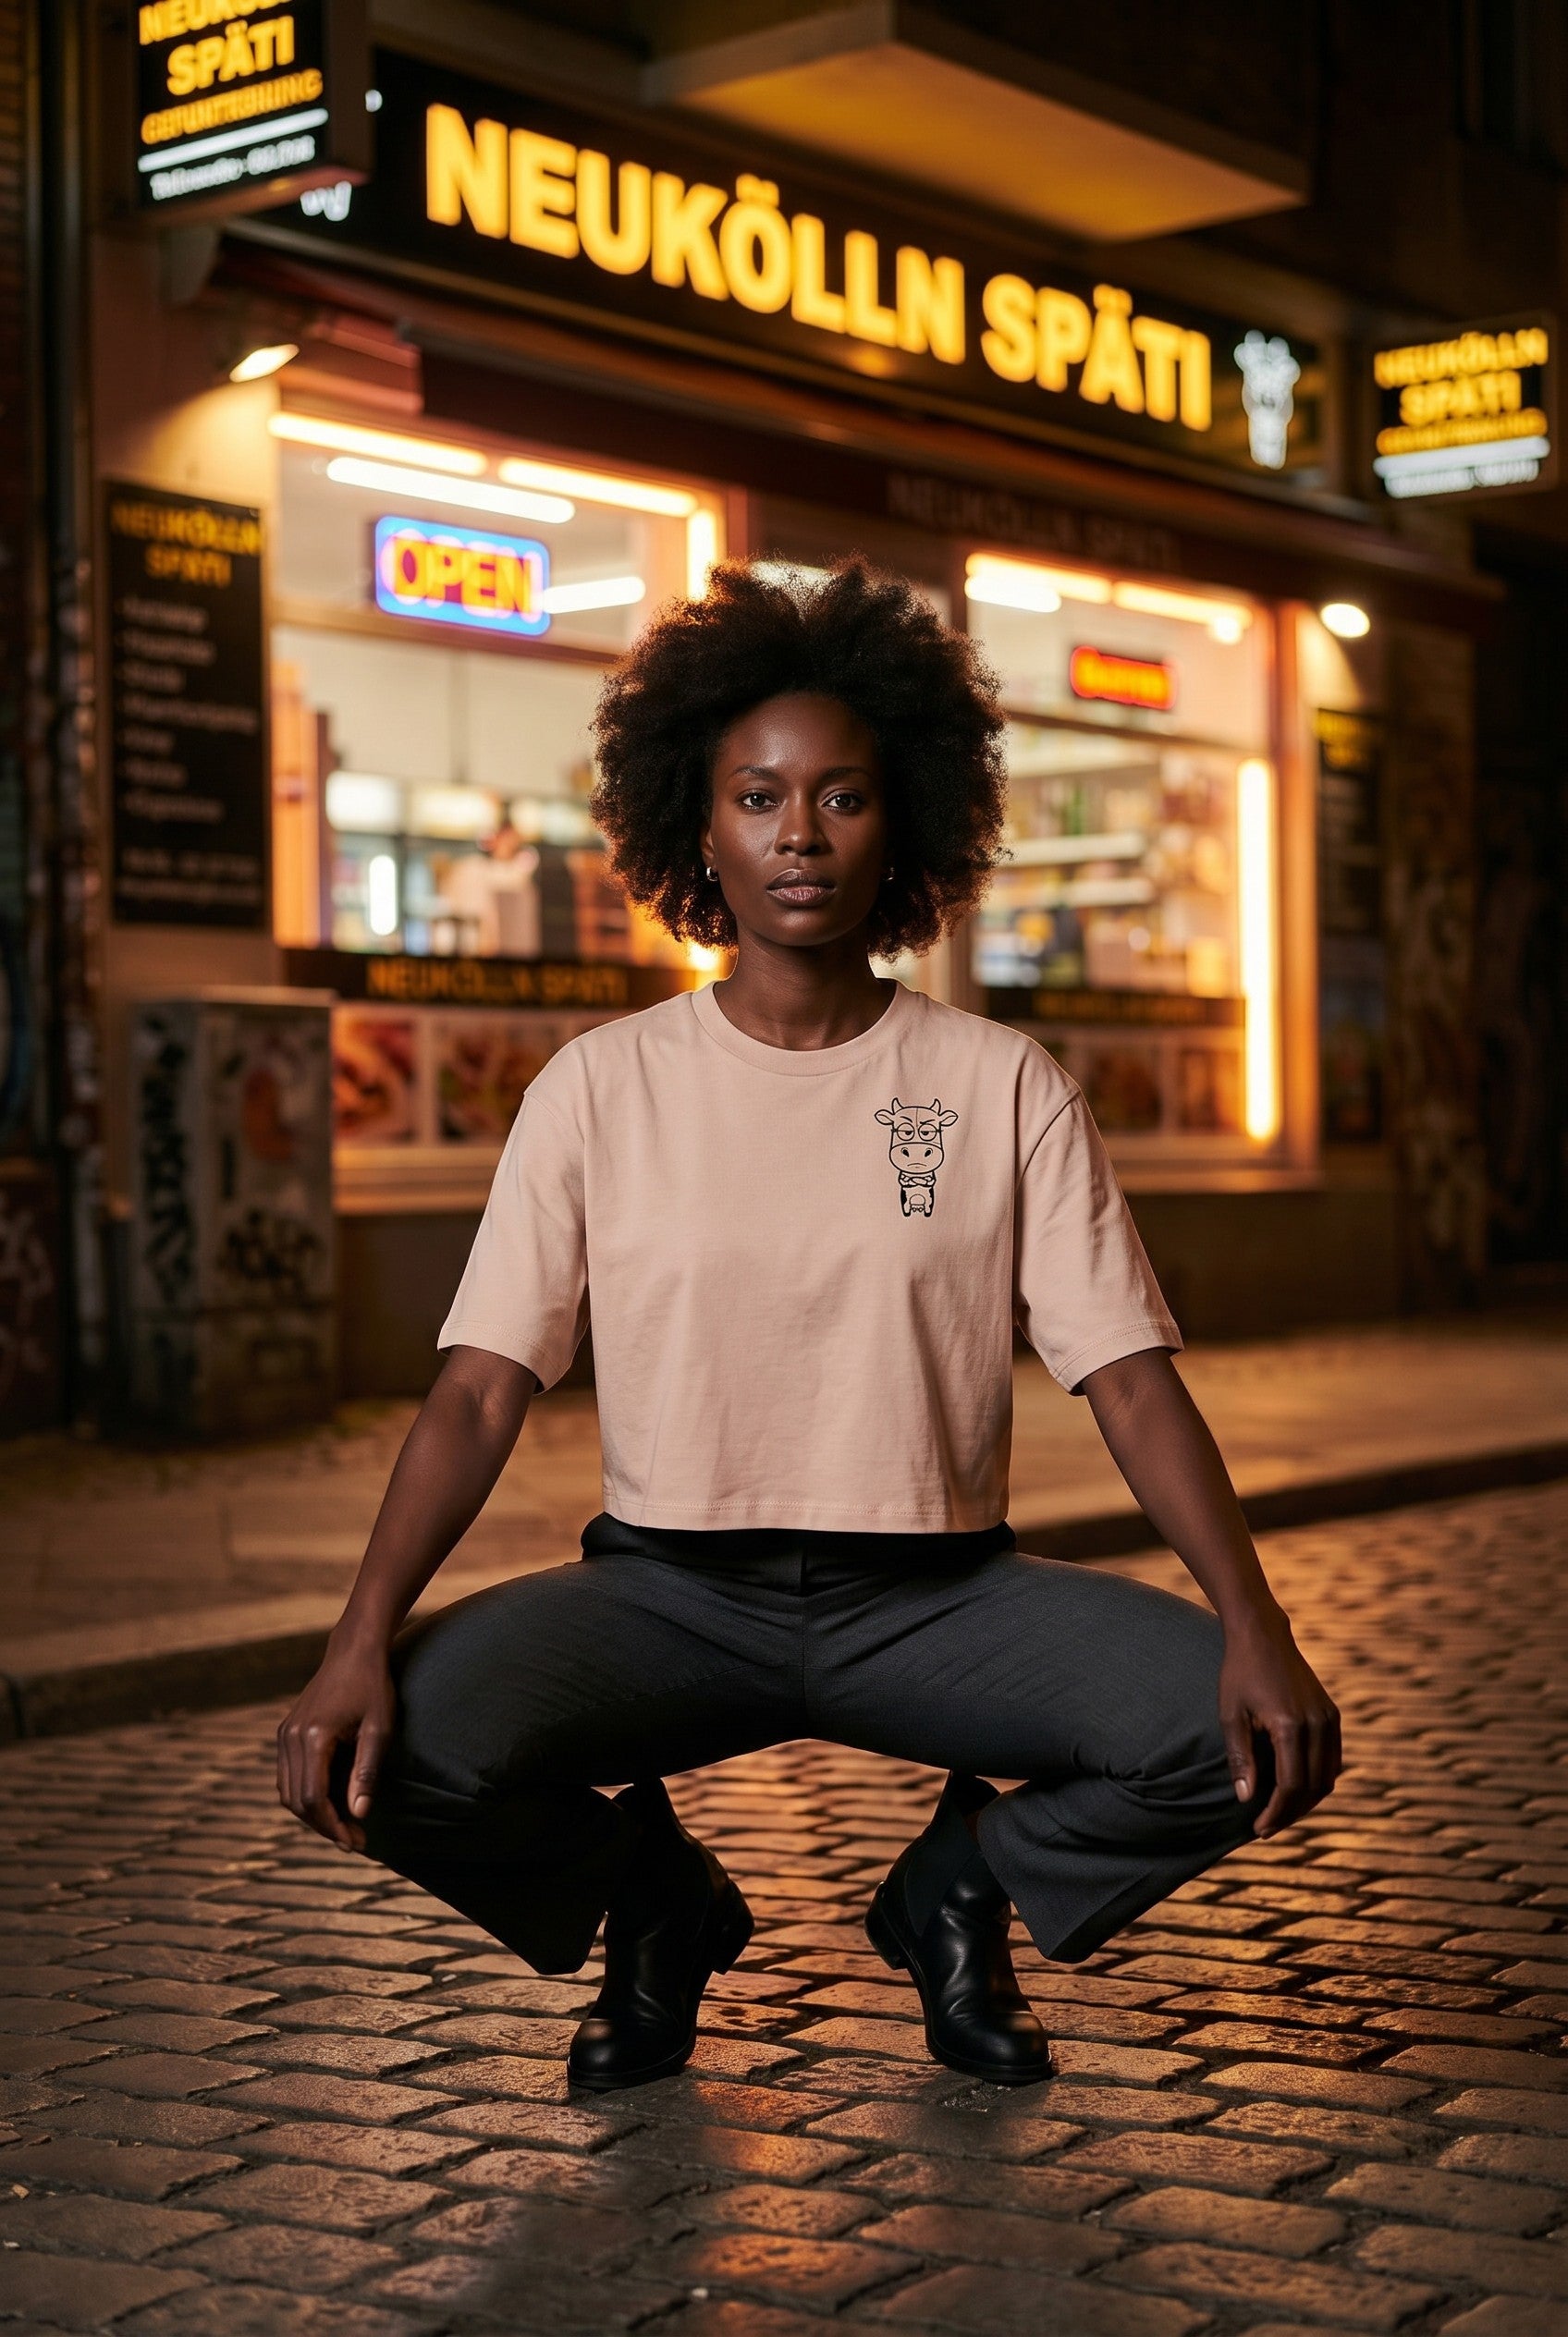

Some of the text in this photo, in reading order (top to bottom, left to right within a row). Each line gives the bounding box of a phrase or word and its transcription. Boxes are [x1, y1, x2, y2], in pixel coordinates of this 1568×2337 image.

[166, 15, 294, 96] SPÄTI
[426, 103, 1212, 432] NEUKÖLLN SPÄTI
[382, 530, 540, 620] OPEN
